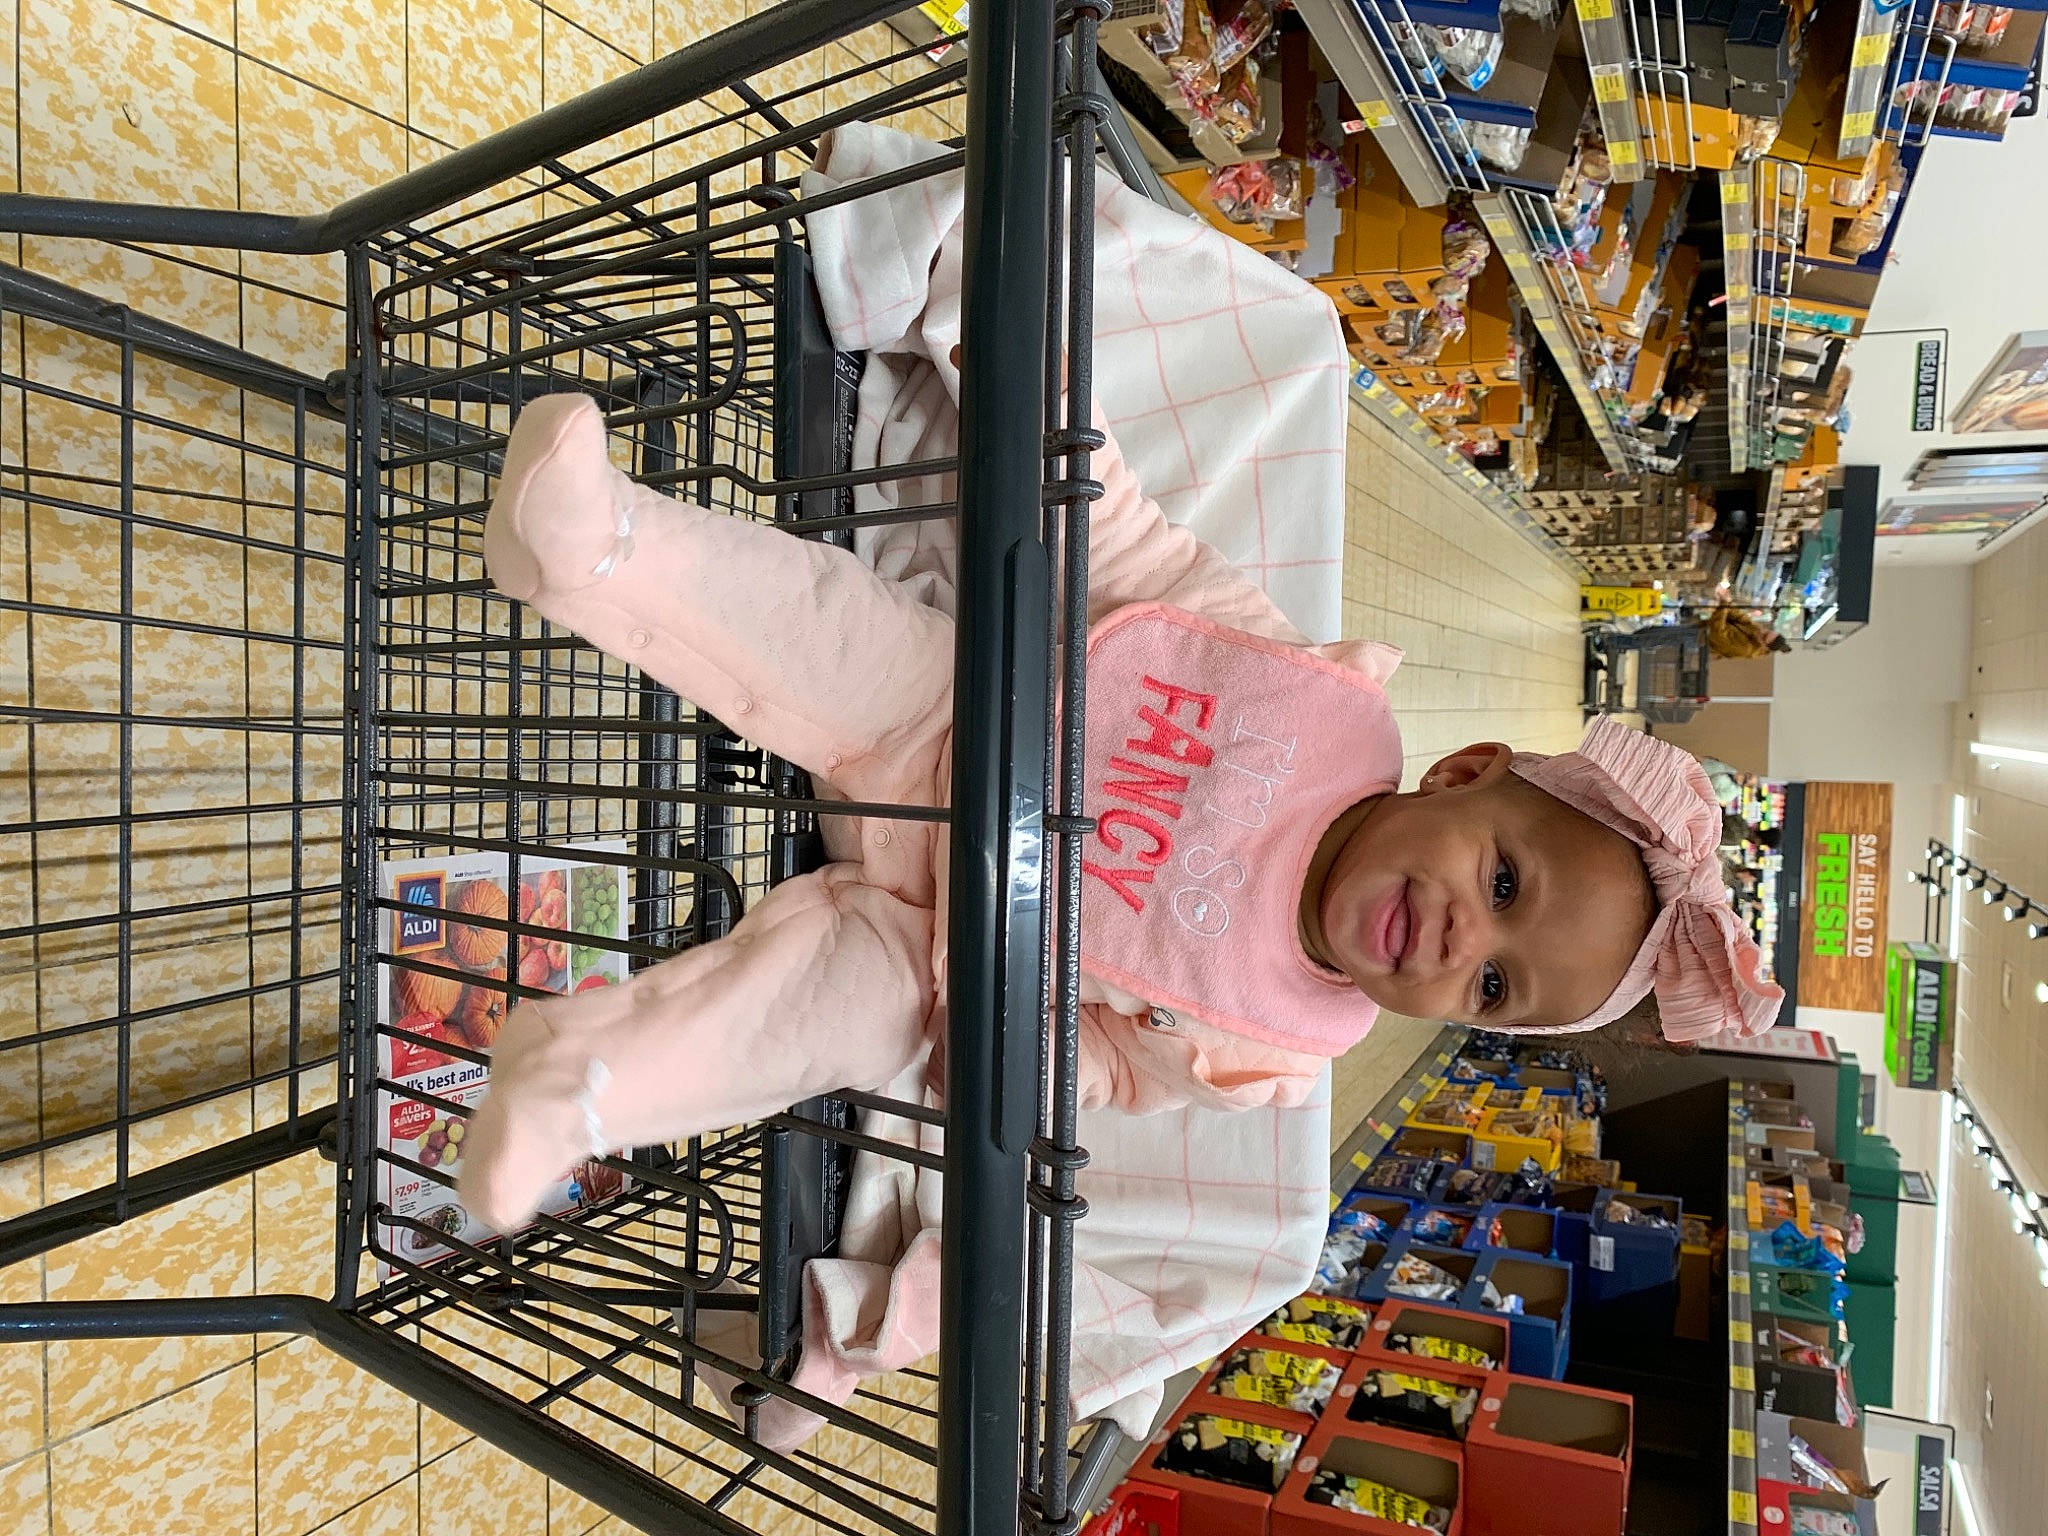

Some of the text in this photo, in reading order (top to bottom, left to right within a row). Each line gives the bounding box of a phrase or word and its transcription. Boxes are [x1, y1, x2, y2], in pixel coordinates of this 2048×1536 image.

[1915, 340, 1938, 431] BREAD & BUNS
[1082, 675, 1217, 914] FANCY
[1014, 782, 1042, 914] ALDI
[403, 918, 437, 937] ALDI
[1812, 833, 1849, 957] FRESH
[1852, 833, 1878, 958] SAY HELLO TO
[401, 1102, 424, 1116] ALDI
[427, 1071, 456, 1091] best
[458, 1065, 483, 1082] and
[394, 1182, 420, 1198] $7.99
[1919, 1465, 1941, 1512] SALSA
